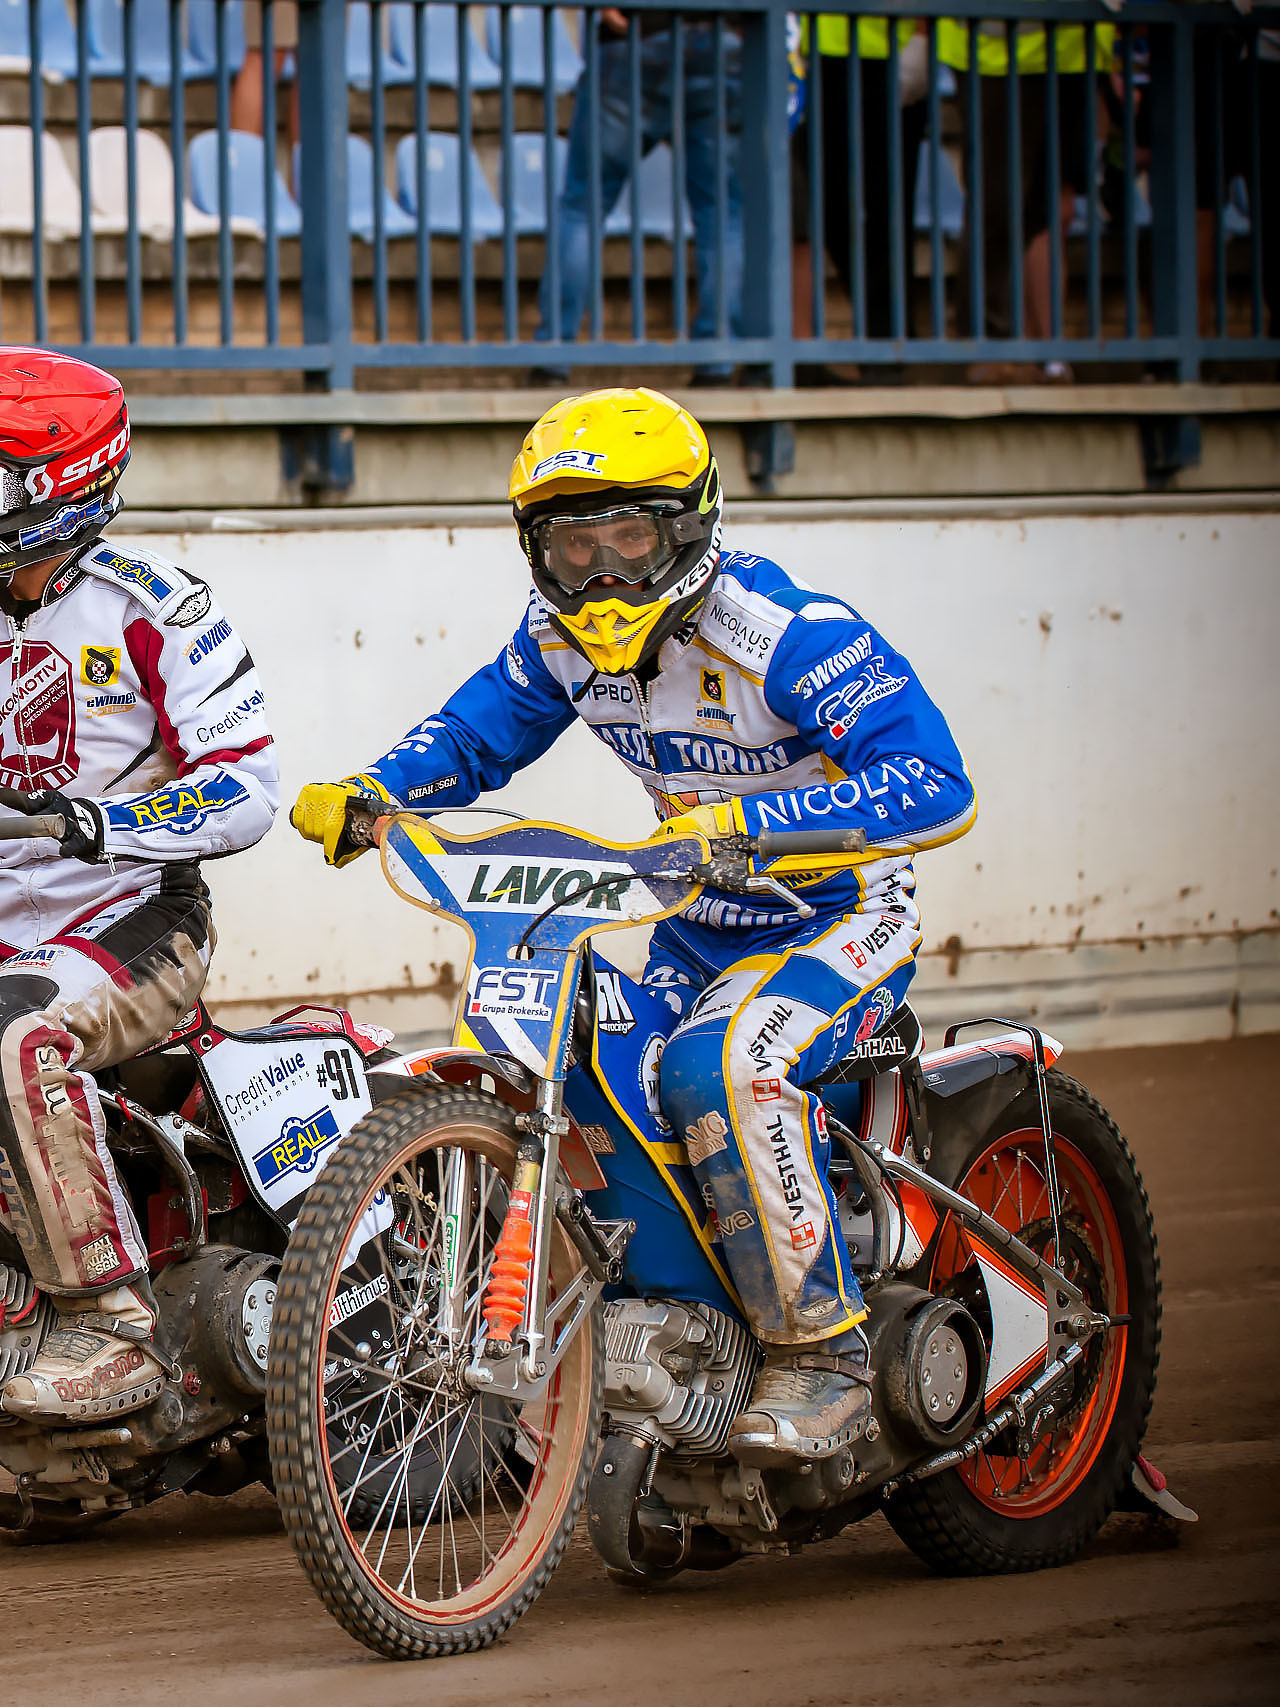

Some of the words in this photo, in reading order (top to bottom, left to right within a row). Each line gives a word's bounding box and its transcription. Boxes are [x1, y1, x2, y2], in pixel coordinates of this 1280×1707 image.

[108, 556, 155, 590] REALL
[710, 604, 771, 652] NICOLAUS
[22, 678, 67, 719] DAUGAVPILS
[23, 702, 53, 729] SPEEDWAY
[50, 689, 67, 706] CLUB
[129, 786, 224, 826] REAL
[467, 864, 632, 912] LAVOR
[473, 970, 556, 1004] FST
[482, 1004, 506, 1016] Grupa
[507, 1005, 549, 1017] Brokerska
[316, 1048, 361, 1101] #91
[271, 1122, 328, 1171] REALL
[765, 1113, 805, 1222] VESTHAL
[329, 1275, 389, 1327] althimus
